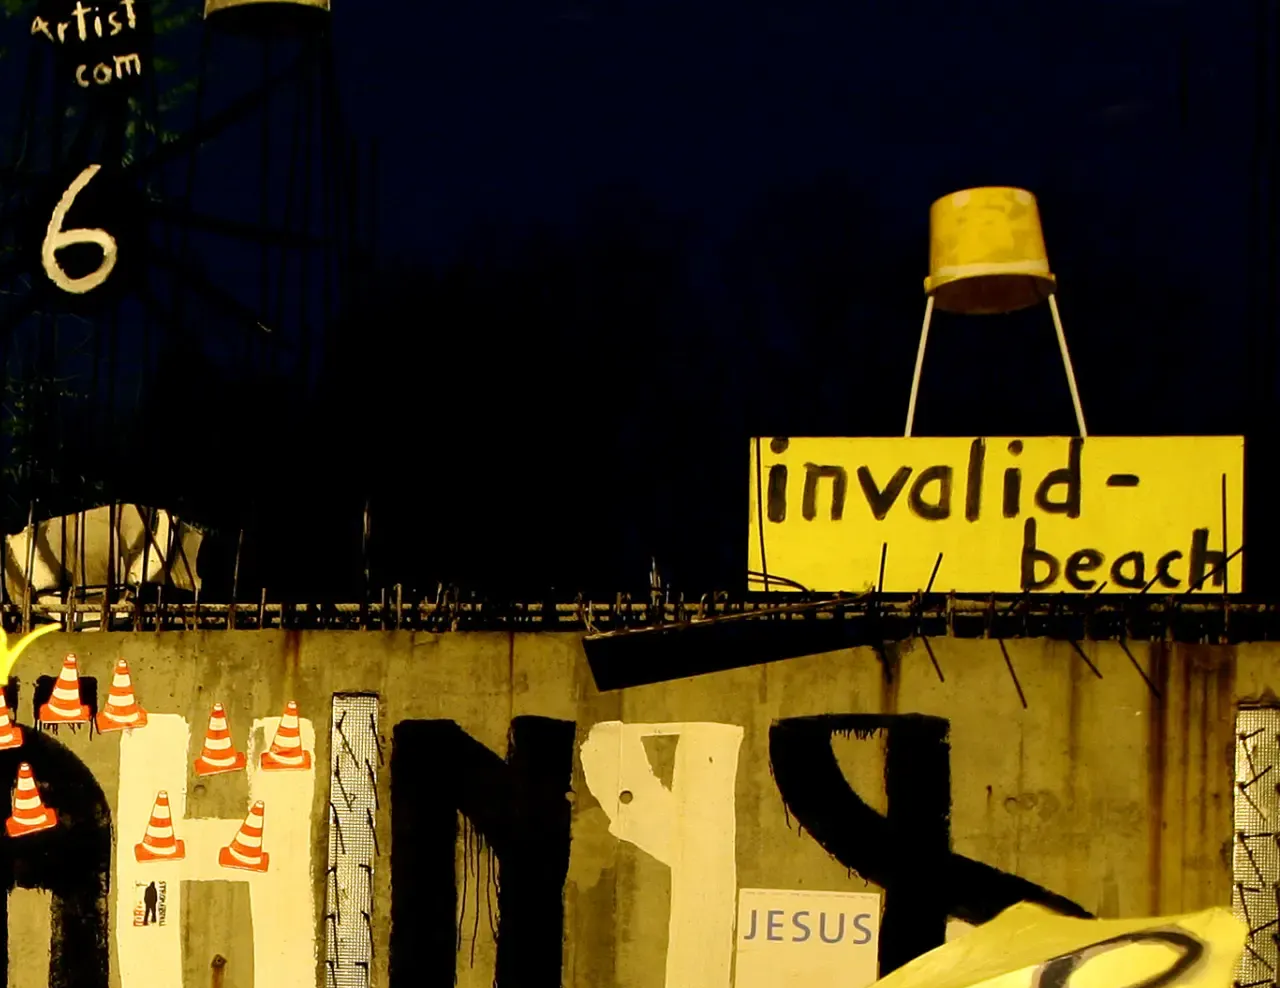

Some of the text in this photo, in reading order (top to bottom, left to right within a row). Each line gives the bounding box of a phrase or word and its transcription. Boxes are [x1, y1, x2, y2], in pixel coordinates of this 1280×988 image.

[75, 53, 141, 87] com
[41, 164, 118, 294] 6
[1020, 516, 1224, 591] beach
[744, 910, 872, 944] JESUS
